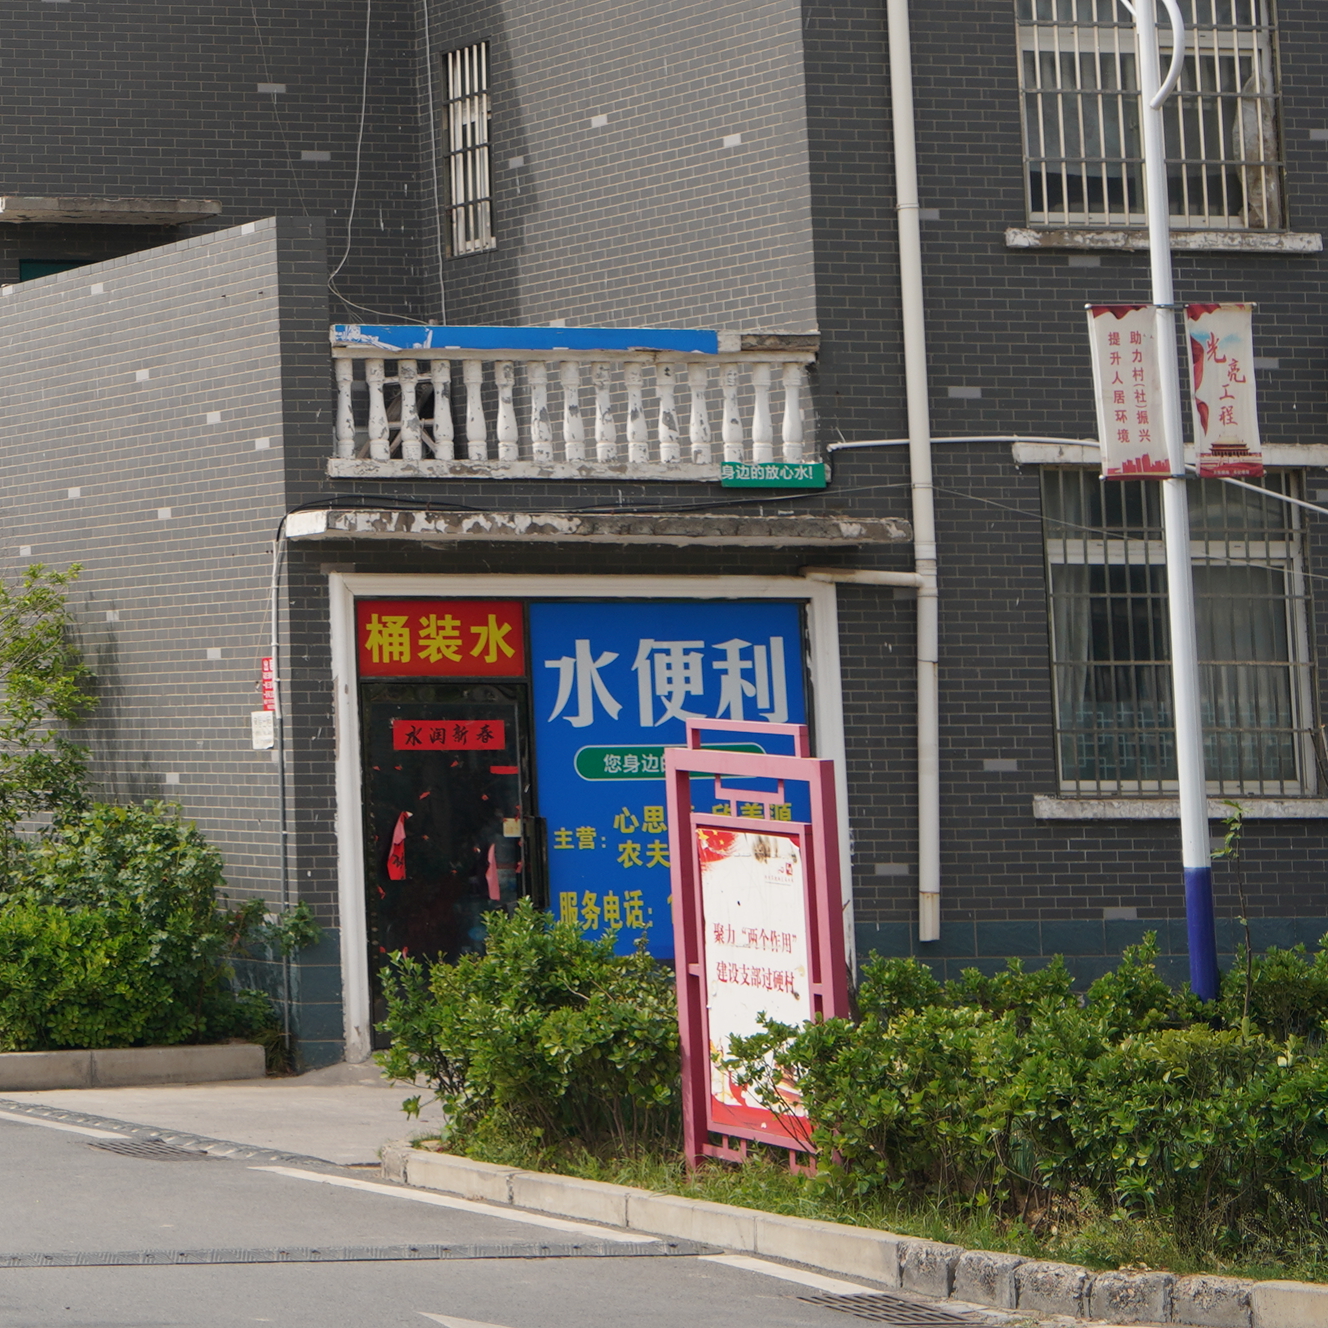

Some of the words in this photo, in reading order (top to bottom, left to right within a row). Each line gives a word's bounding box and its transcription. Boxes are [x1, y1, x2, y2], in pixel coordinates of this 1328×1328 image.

[1108, 332, 1130, 443] 提升人居环境
[1206, 332, 1246, 425] 光亮工程
[365, 614, 515, 663] 桶装水
[545, 637, 789, 728] 水便利
[404, 724, 494, 746] 水润新春
[716, 960, 796, 994] 建设支部过硬村
